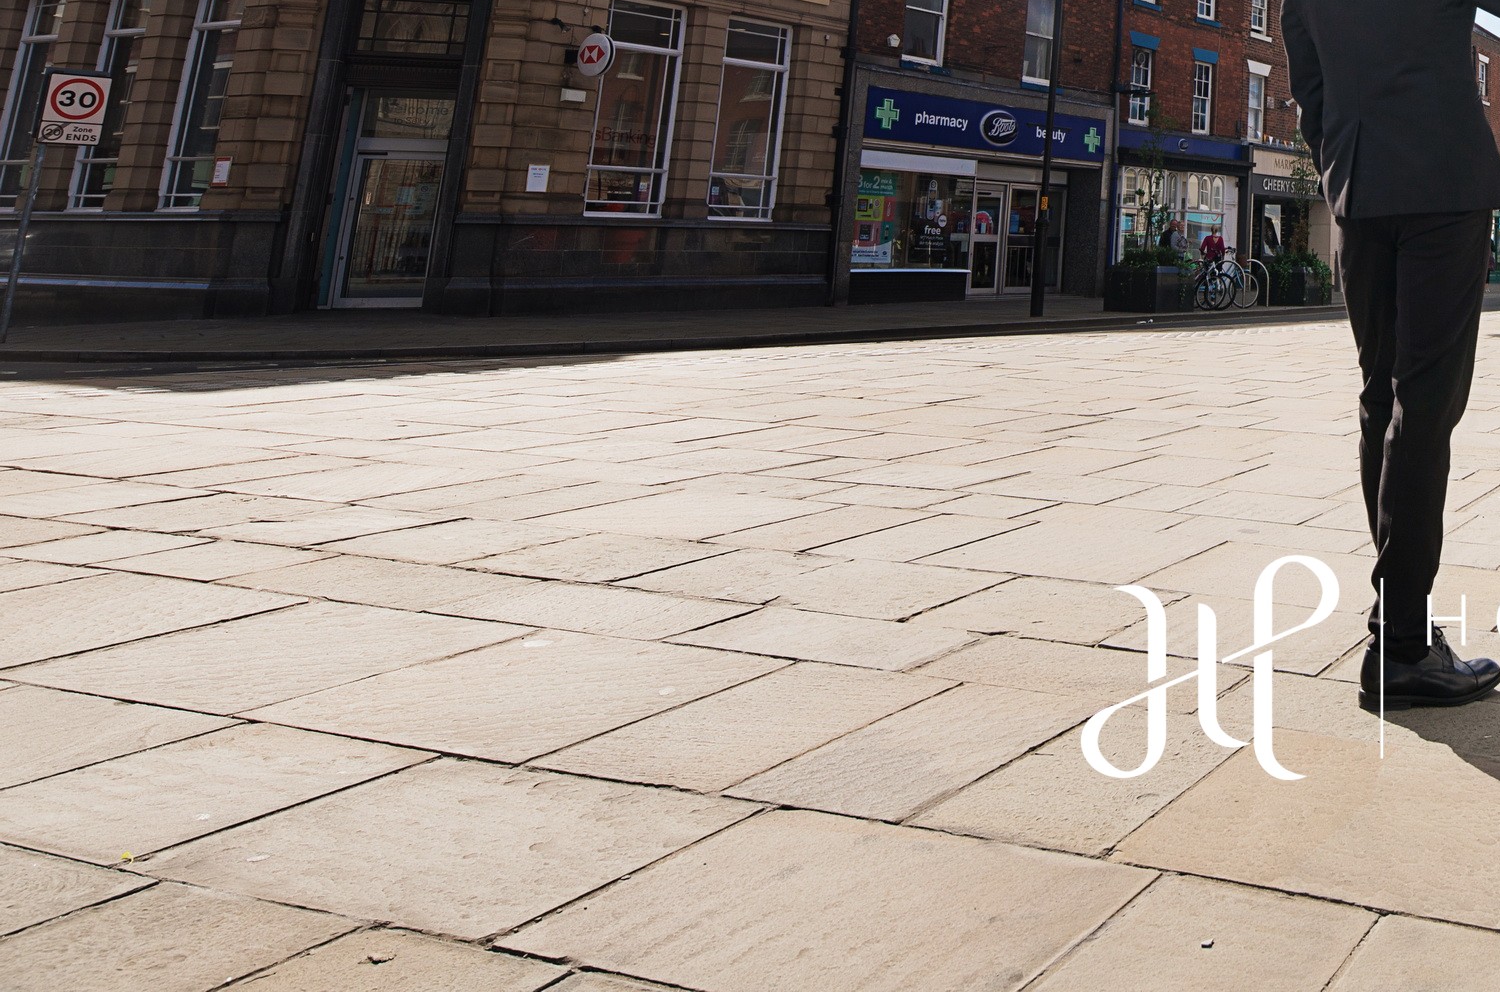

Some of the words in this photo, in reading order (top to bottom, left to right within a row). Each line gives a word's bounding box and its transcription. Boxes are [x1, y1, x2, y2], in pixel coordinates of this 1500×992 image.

[58, 90, 97, 109] 30
[45, 128, 61, 137] 20
[914, 111, 969, 131] pharmacy
[988, 117, 1016, 137] Boots
[1036, 126, 1066, 143] beuty
[65, 133, 97, 142] ENDS
[873, 175, 880, 189] 2
[1262, 178, 1291, 192] CHEEKY
[924, 225, 941, 235] free
